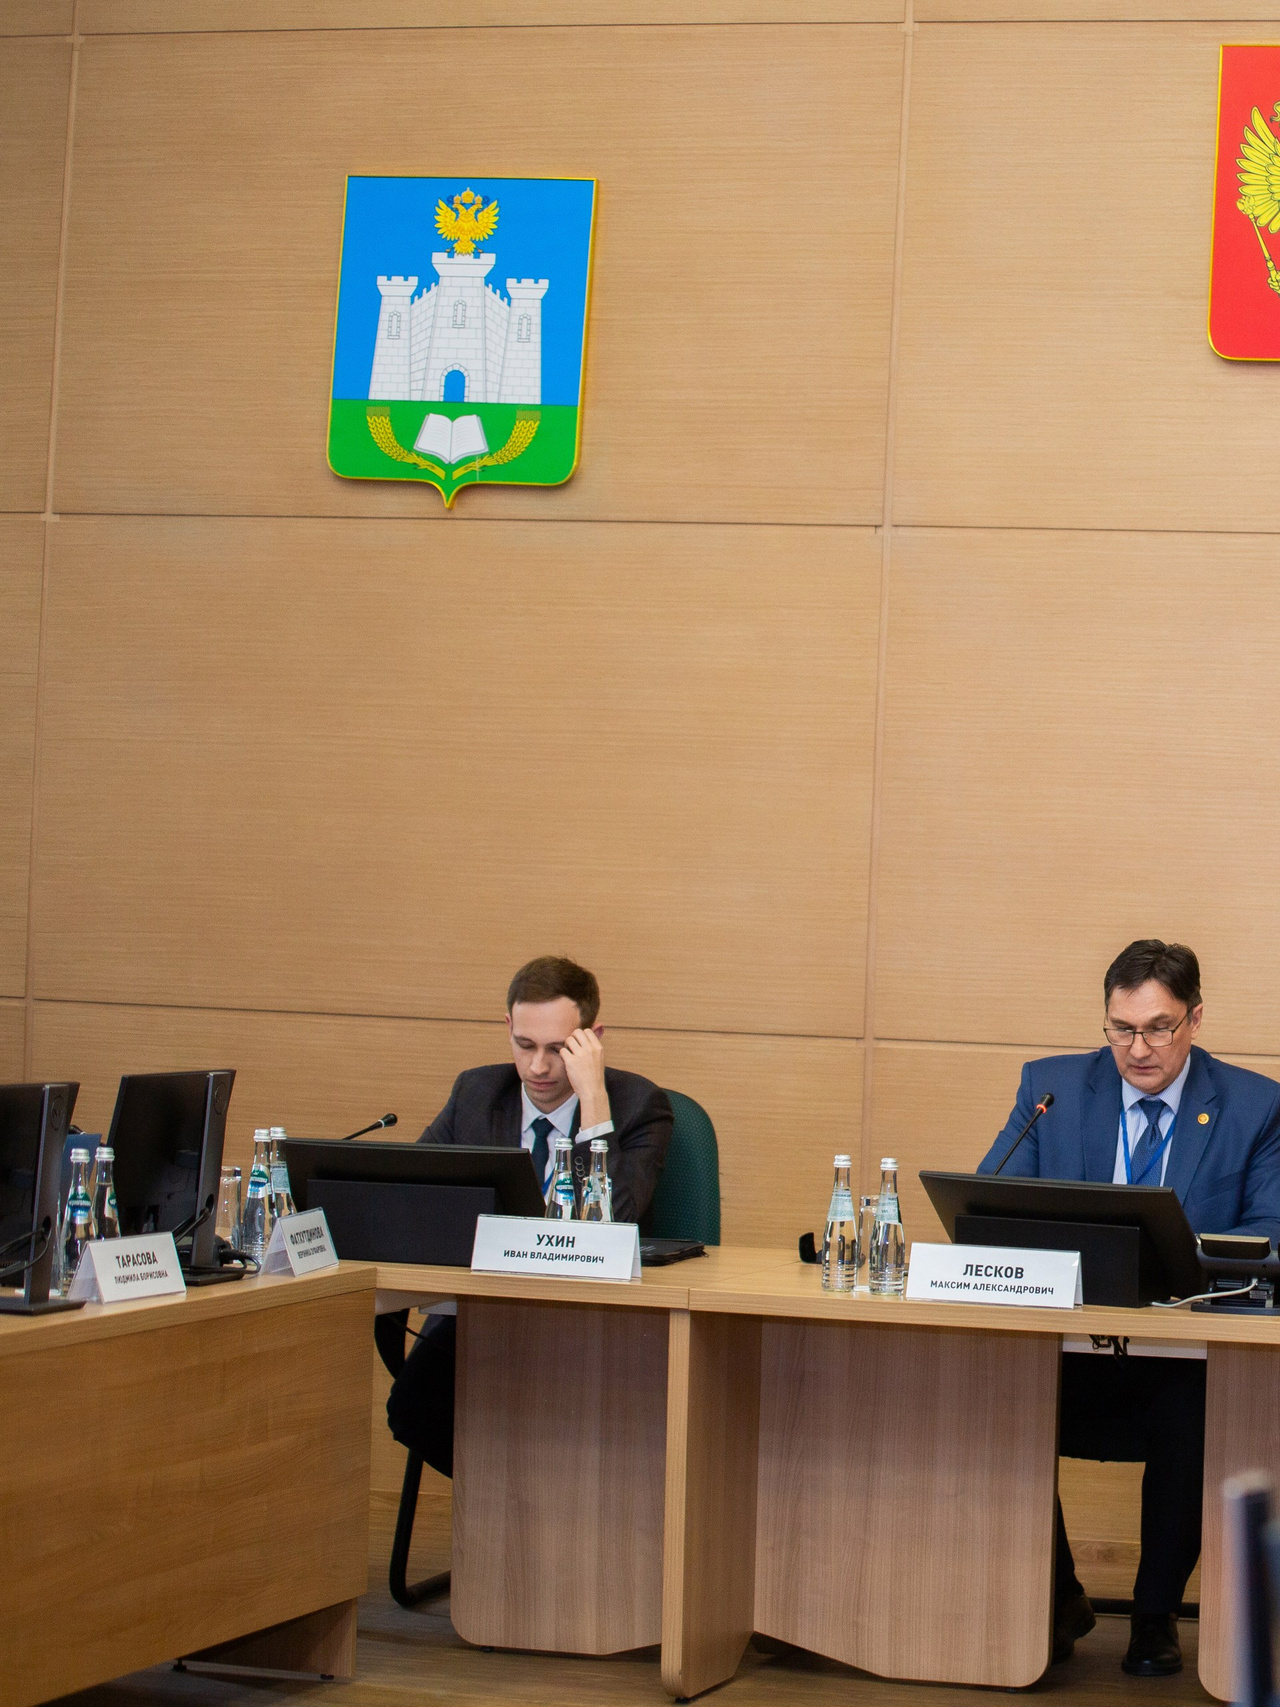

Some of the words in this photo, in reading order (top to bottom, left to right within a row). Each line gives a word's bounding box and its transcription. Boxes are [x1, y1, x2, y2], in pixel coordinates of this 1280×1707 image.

[536, 1234, 576, 1248] УХИН
[115, 1251, 158, 1269] ТАРАСОВА
[503, 1249, 528, 1258] ИВАН
[529, 1251, 605, 1264] ВЛАДИМИРОВИЧ
[114, 1273, 140, 1285] ЛЮДМИЛА
[139, 1270, 169, 1281] БОРИСОВНА
[963, 1264, 1025, 1279] ЛЕСКОВ
[930, 1280, 971, 1290] МАКСИМ
[972, 1283, 1055, 1295] АЛЕКСАНДРОВИЧ
